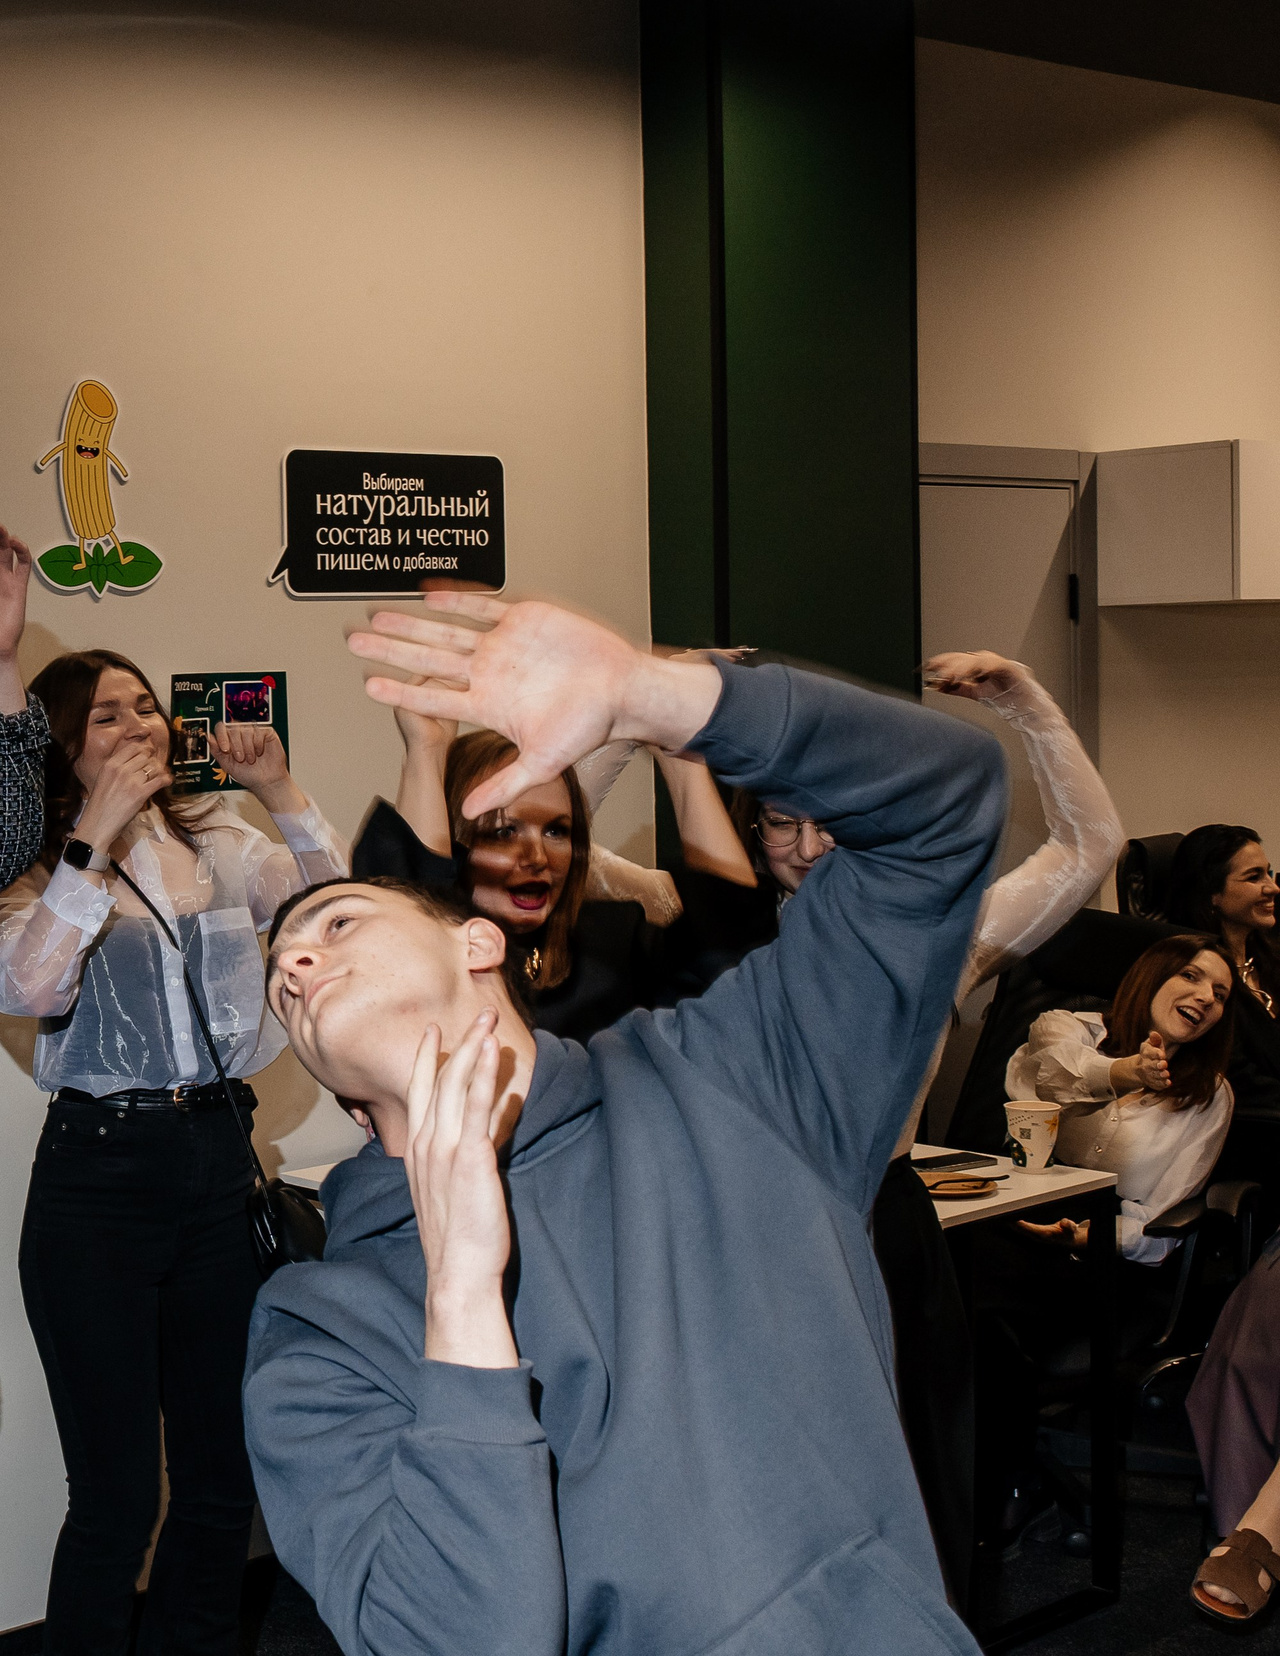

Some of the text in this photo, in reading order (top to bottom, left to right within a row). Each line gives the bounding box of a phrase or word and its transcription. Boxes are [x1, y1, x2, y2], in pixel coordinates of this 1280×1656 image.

[363, 472, 424, 494] Выбираем
[316, 489, 490, 525] натуральный
[316, 527, 489, 547] состав и честно
[316, 552, 458, 572] пишем о добавках
[174, 681, 203, 691] 2022 год
